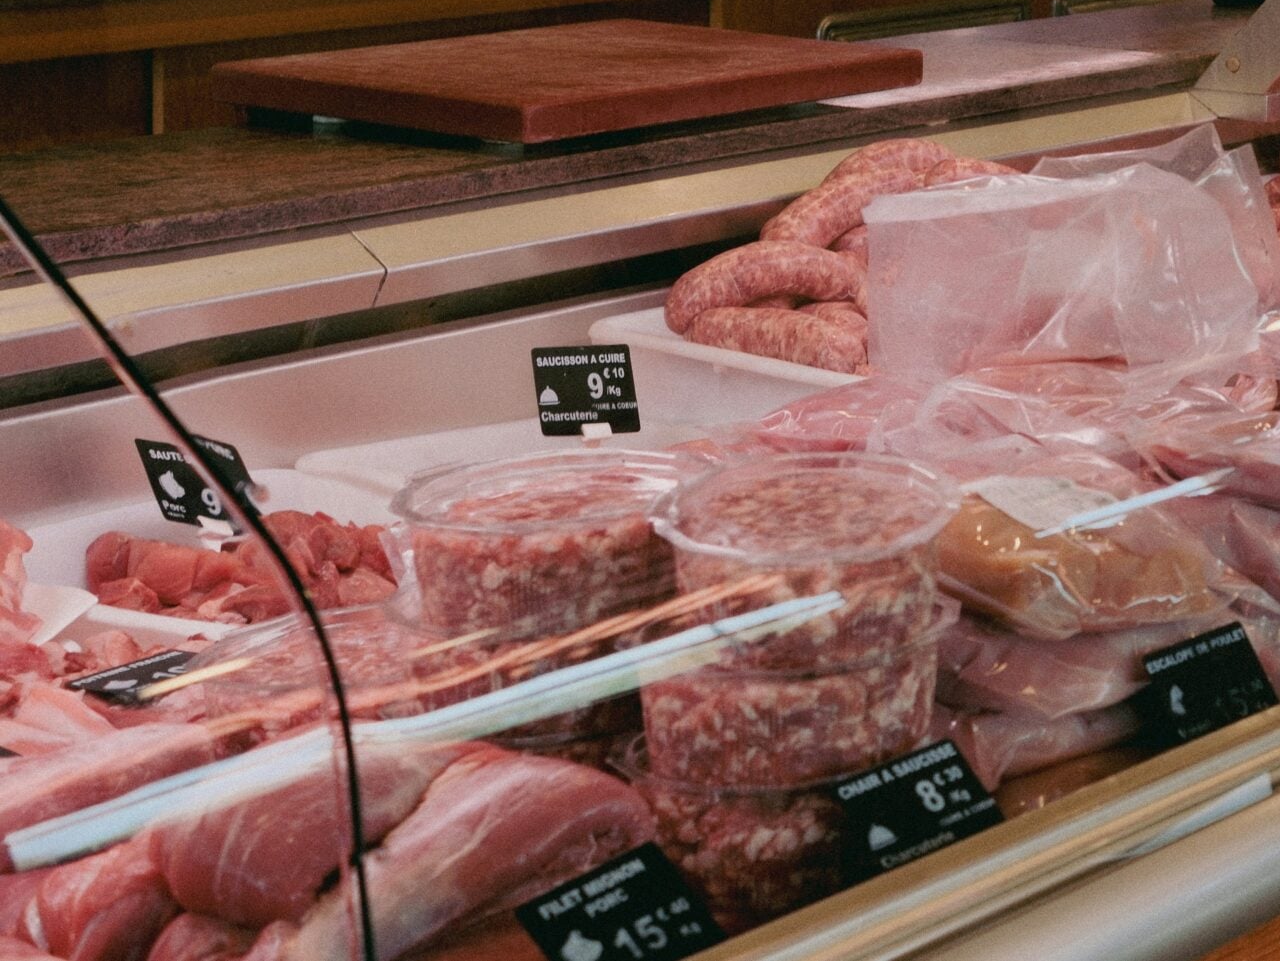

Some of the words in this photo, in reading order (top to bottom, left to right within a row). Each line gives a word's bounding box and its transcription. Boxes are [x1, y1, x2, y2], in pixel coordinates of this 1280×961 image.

[537, 355, 588, 367] SAUCISSON
[591, 354, 597, 364] A
[599, 353, 625, 363] CUIRE
[587, 372, 603, 399] 9
[542, 411, 598, 422] Charcuterie
[162, 500, 186, 513] Porc
[201, 488, 222, 515] 9
[1146, 647, 1195, 674] ESCALOPE
[1210, 628, 1245, 648] POULET
[838, 773, 882, 800] CHAIR
[881, 769, 895, 783] A
[892, 742, 957, 778] SAUCISSE
[915, 779, 945, 812] 8
[538, 889, 582, 920] FILET
[582, 858, 645, 897] MIGNON
[584, 889, 628, 918] PORC
[614, 915, 667, 959] 15
